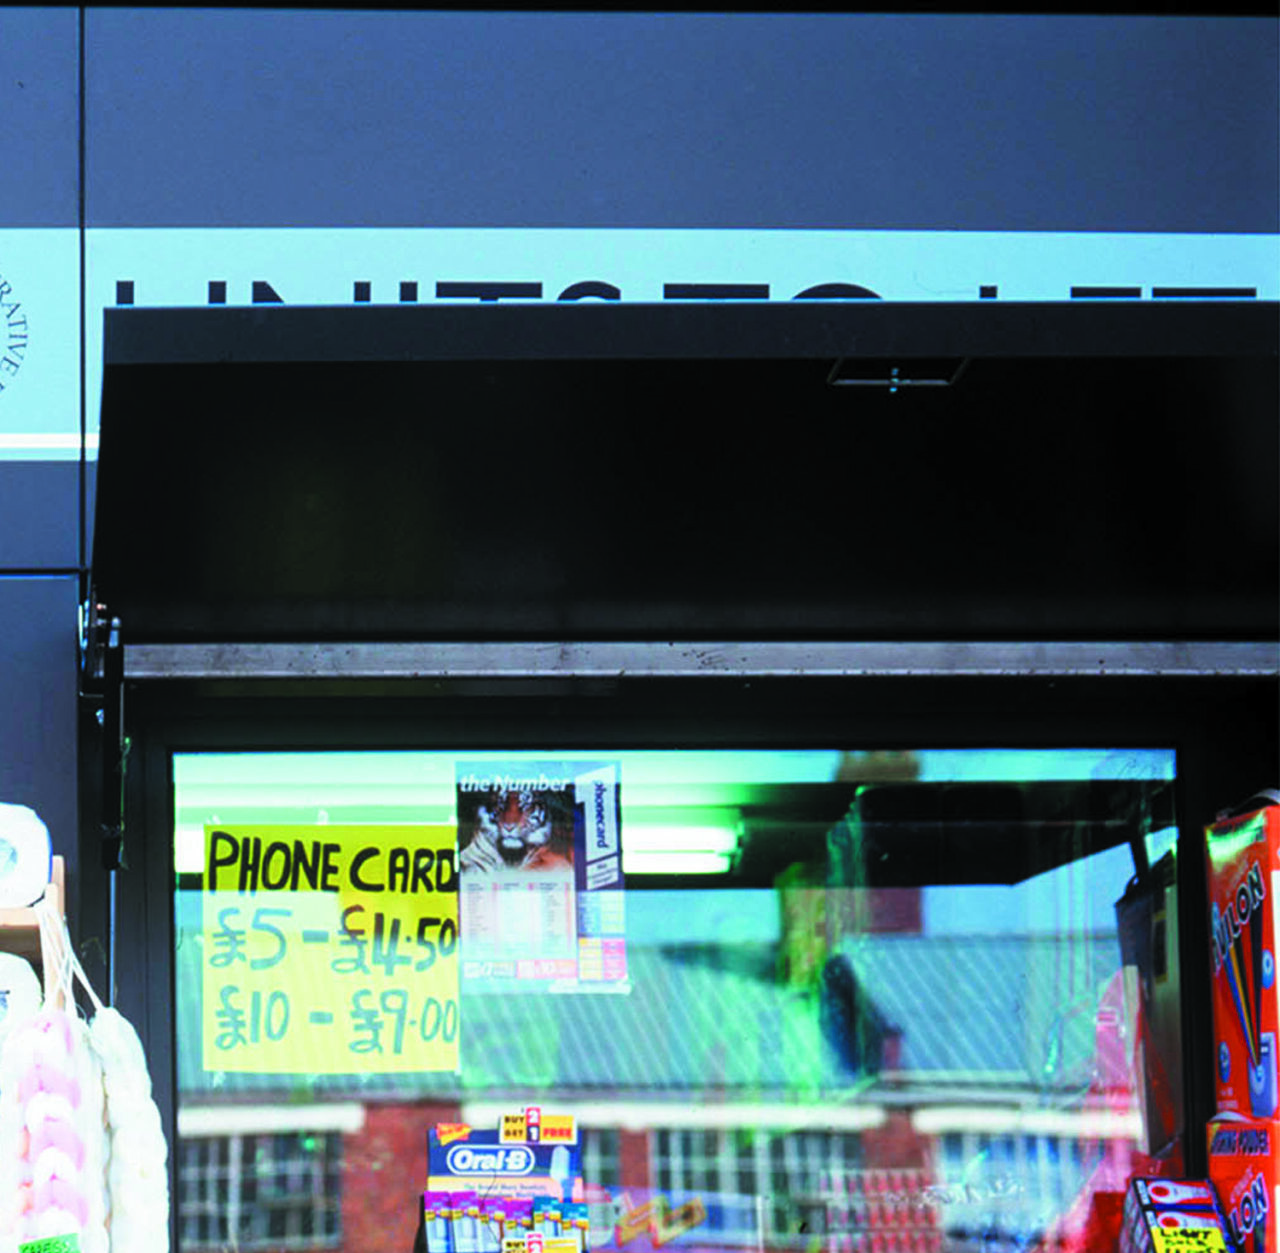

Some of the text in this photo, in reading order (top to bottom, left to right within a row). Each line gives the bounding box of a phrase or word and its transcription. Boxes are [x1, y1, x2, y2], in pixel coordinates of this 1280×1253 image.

[460, 775, 570, 793] the Number
[208, 831, 340, 893] PHONE
[209, 907, 293, 970] £5
[331, 905, 458, 976] £4.50
[215, 985, 458, 1054] £10 £9.00
[543, 1128, 572, 1138] FREE
[453, 1149, 529, 1170] Oral-B
